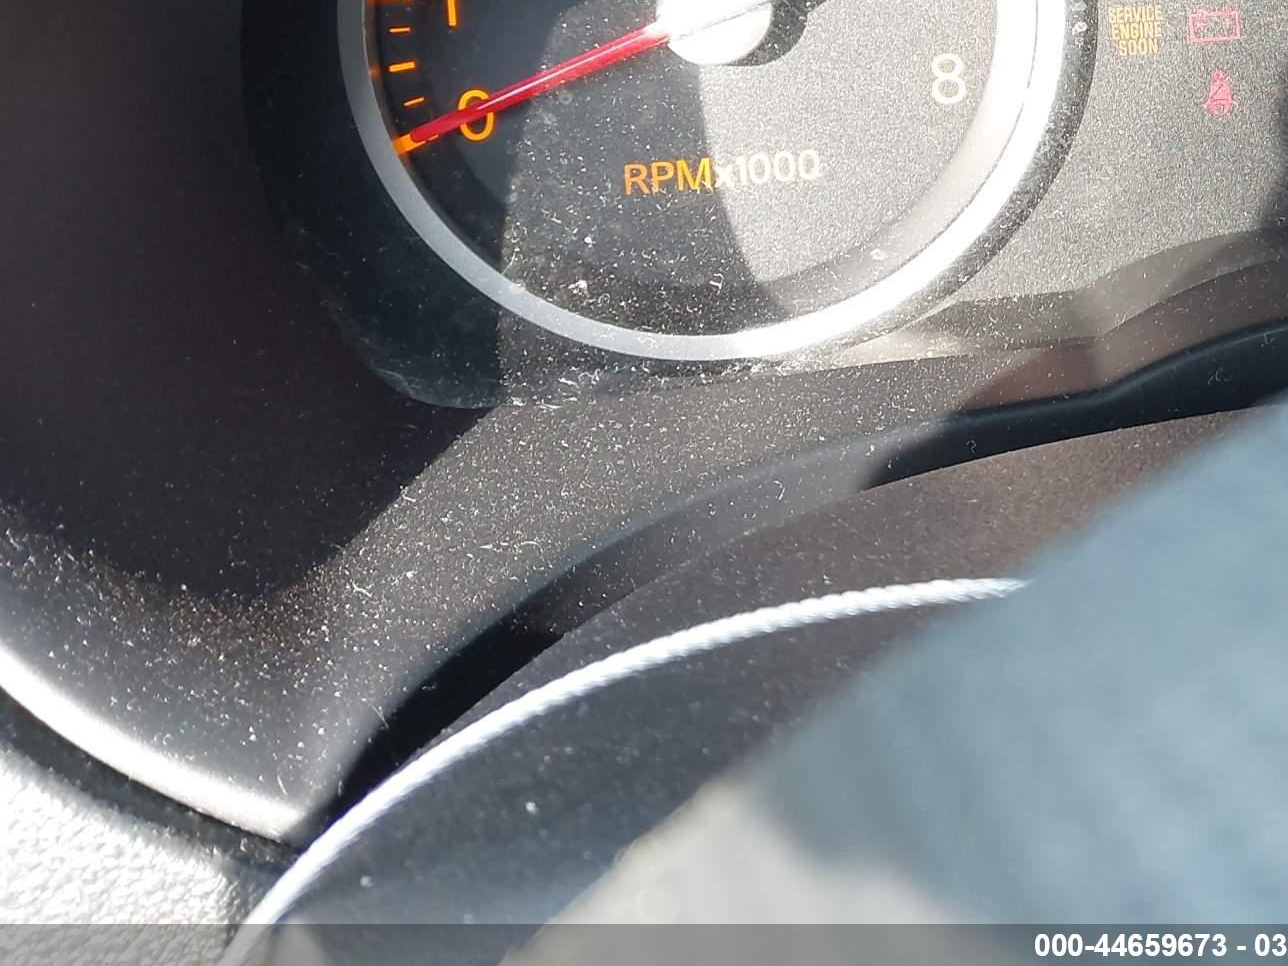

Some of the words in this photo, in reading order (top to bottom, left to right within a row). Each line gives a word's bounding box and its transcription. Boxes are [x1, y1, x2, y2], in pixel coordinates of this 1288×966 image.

[1107, 2, 1164, 24] SERVICE
[1110, 20, 1163, 40] ENGINE
[1118, 37, 1159, 57] SOON
[931, 53, 967, 105] 8
[457, 89, 495, 142] 0
[623, 148, 821, 197] RPMx1000
